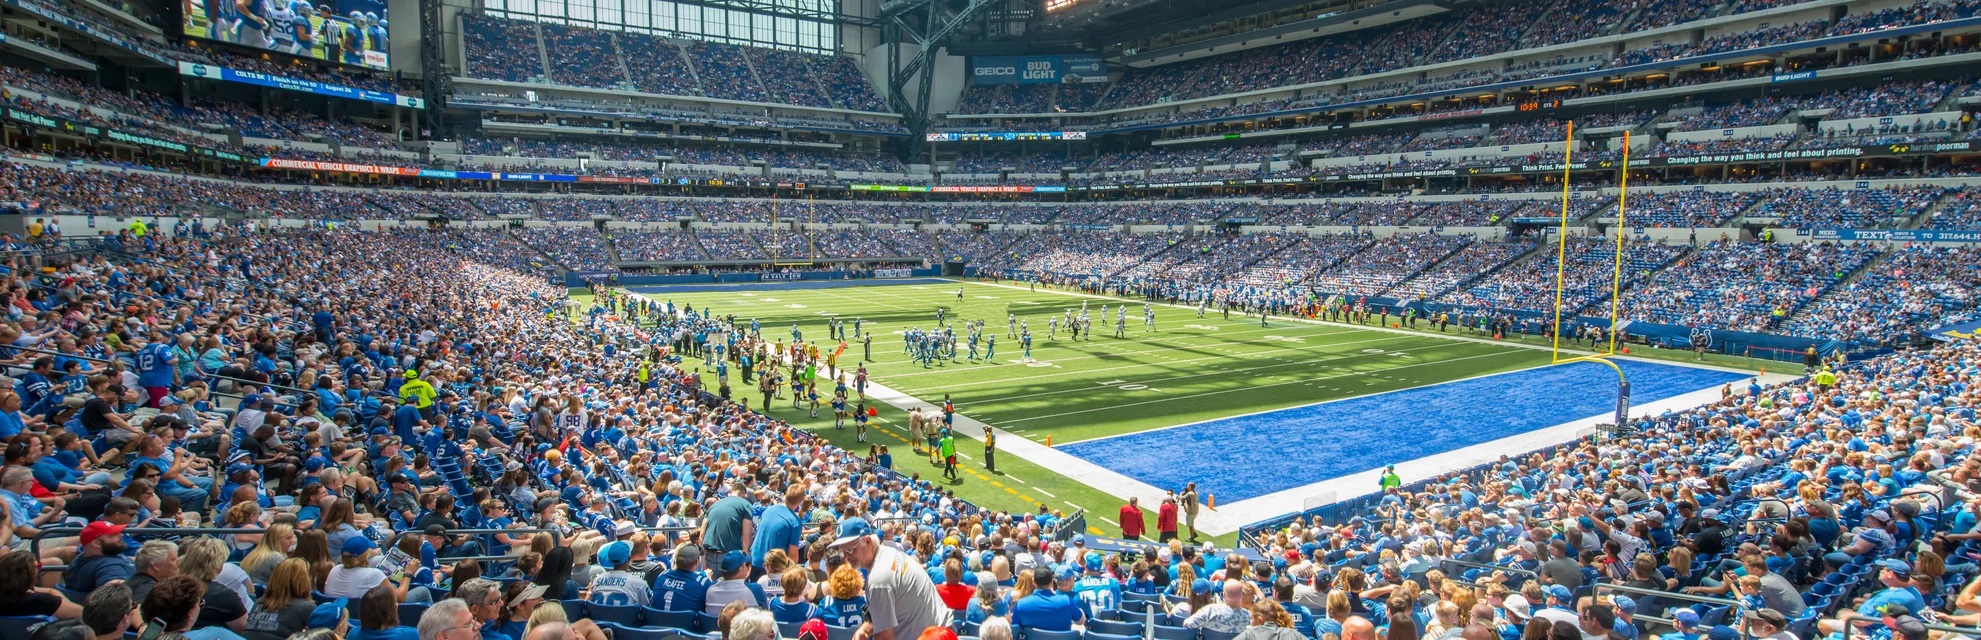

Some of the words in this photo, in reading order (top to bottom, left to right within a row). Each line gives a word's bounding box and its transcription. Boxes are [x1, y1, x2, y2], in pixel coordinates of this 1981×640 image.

[367, 54, 385, 64] meijer
[975, 67, 1015, 75] GEICO
[1027, 61, 1051, 71] BUD
[1022, 70, 1056, 80] LIGHT
[1791, 72, 1811, 80] LIGHT
[235, 71, 254, 79] COLTS
[273, 76, 290, 84] Finish
[325, 84, 344, 92] August
[1520, 102, 1538, 111] 10:39
[1667, 156, 1699, 165] Changing
[1714, 155, 1728, 163] way
[1730, 153, 1744, 162] you
[1745, 151, 1765, 160] think
[1783, 149, 1799, 158] feel
[1801, 149, 1825, 157] about
[1827, 147, 1863, 158] printing.
[272, 159, 316, 169] COMMERCIAL
[344, 164, 373, 172] GRAPHICS
[381, 166, 399, 174] WRAPS
[1522, 164, 1537, 172] Think
[1539, 163, 1554, 171] Print.
[1437, 168, 1456, 176] printing.
[1854, 231, 1887, 239] TEXT
[139, 355, 154, 370] 12
[566, 416, 581, 427] 98
[596, 576, 627, 587] SANDERS
[663, 578, 686, 590] McAFEE
[768, 579, 781, 588] WAY
[1082, 579, 1110, 587] SANDERS
[663, 591, 674, 611] 1
[843, 604, 857, 613] LUCK
[838, 615, 862, 629] 12
